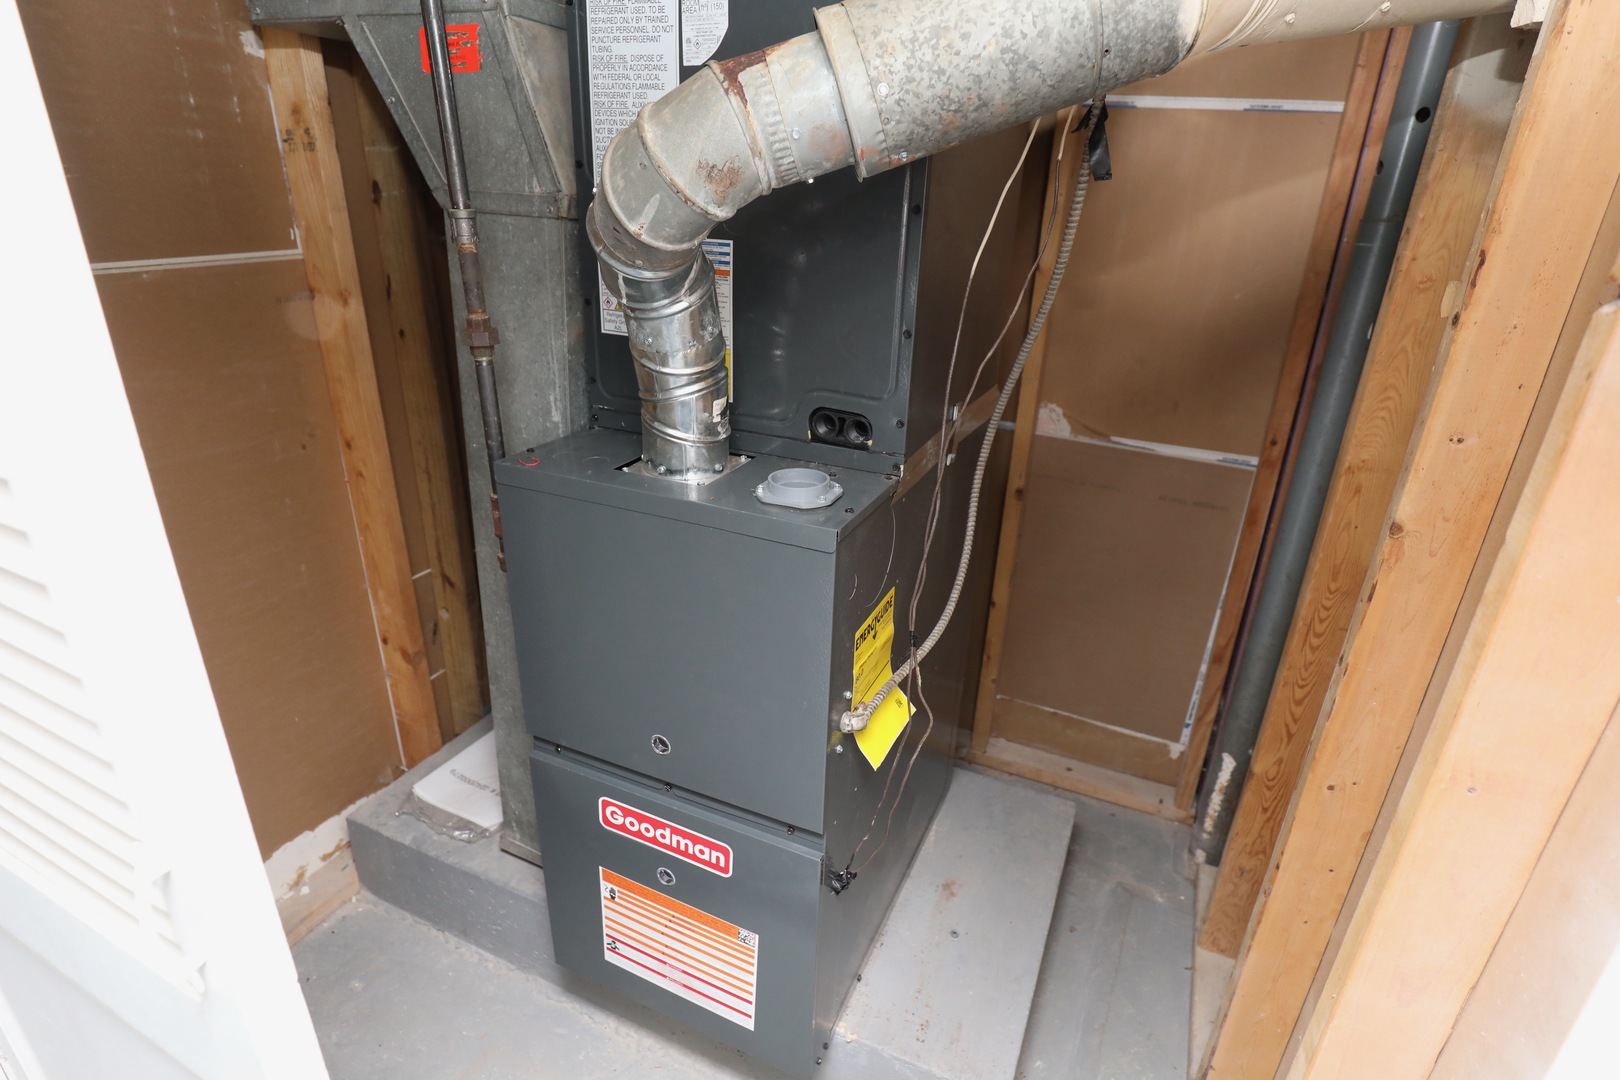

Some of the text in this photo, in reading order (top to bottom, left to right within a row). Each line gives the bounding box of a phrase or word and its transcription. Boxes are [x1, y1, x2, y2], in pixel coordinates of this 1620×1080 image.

[590, 5, 666, 16] REFRIGERANT USED. TO BE
[590, 15, 669, 25] REPAIRED ONLY BY TRAINED
[591, 25, 674, 34] SERVICE PERSONNEL. DO NOT
[591, 35, 661, 44] PUNCTURE REFRIGERANT
[591, 45, 613, 53] TUBING.
[630, 54, 654, 62] DISPOSE
[655, 54, 664, 62] OF
[592, 63, 668, 72] PROPERLY IN ACCORDANCE
[607, 73, 632, 81] FEDERAL
[633, 73, 642, 81] OR
[643, 73, 661, 81] LOCAL
[593, 91, 631, 99] REFRIGERANT
[594, 109, 617, 117] DEVICES
[618, 109, 637, 117] WHICH
[595, 118, 618, 126] IGNITION
[595, 127, 606, 135] NOT
[607, 127, 614, 135] BE
[605, 805, 726, 868] Goodman
